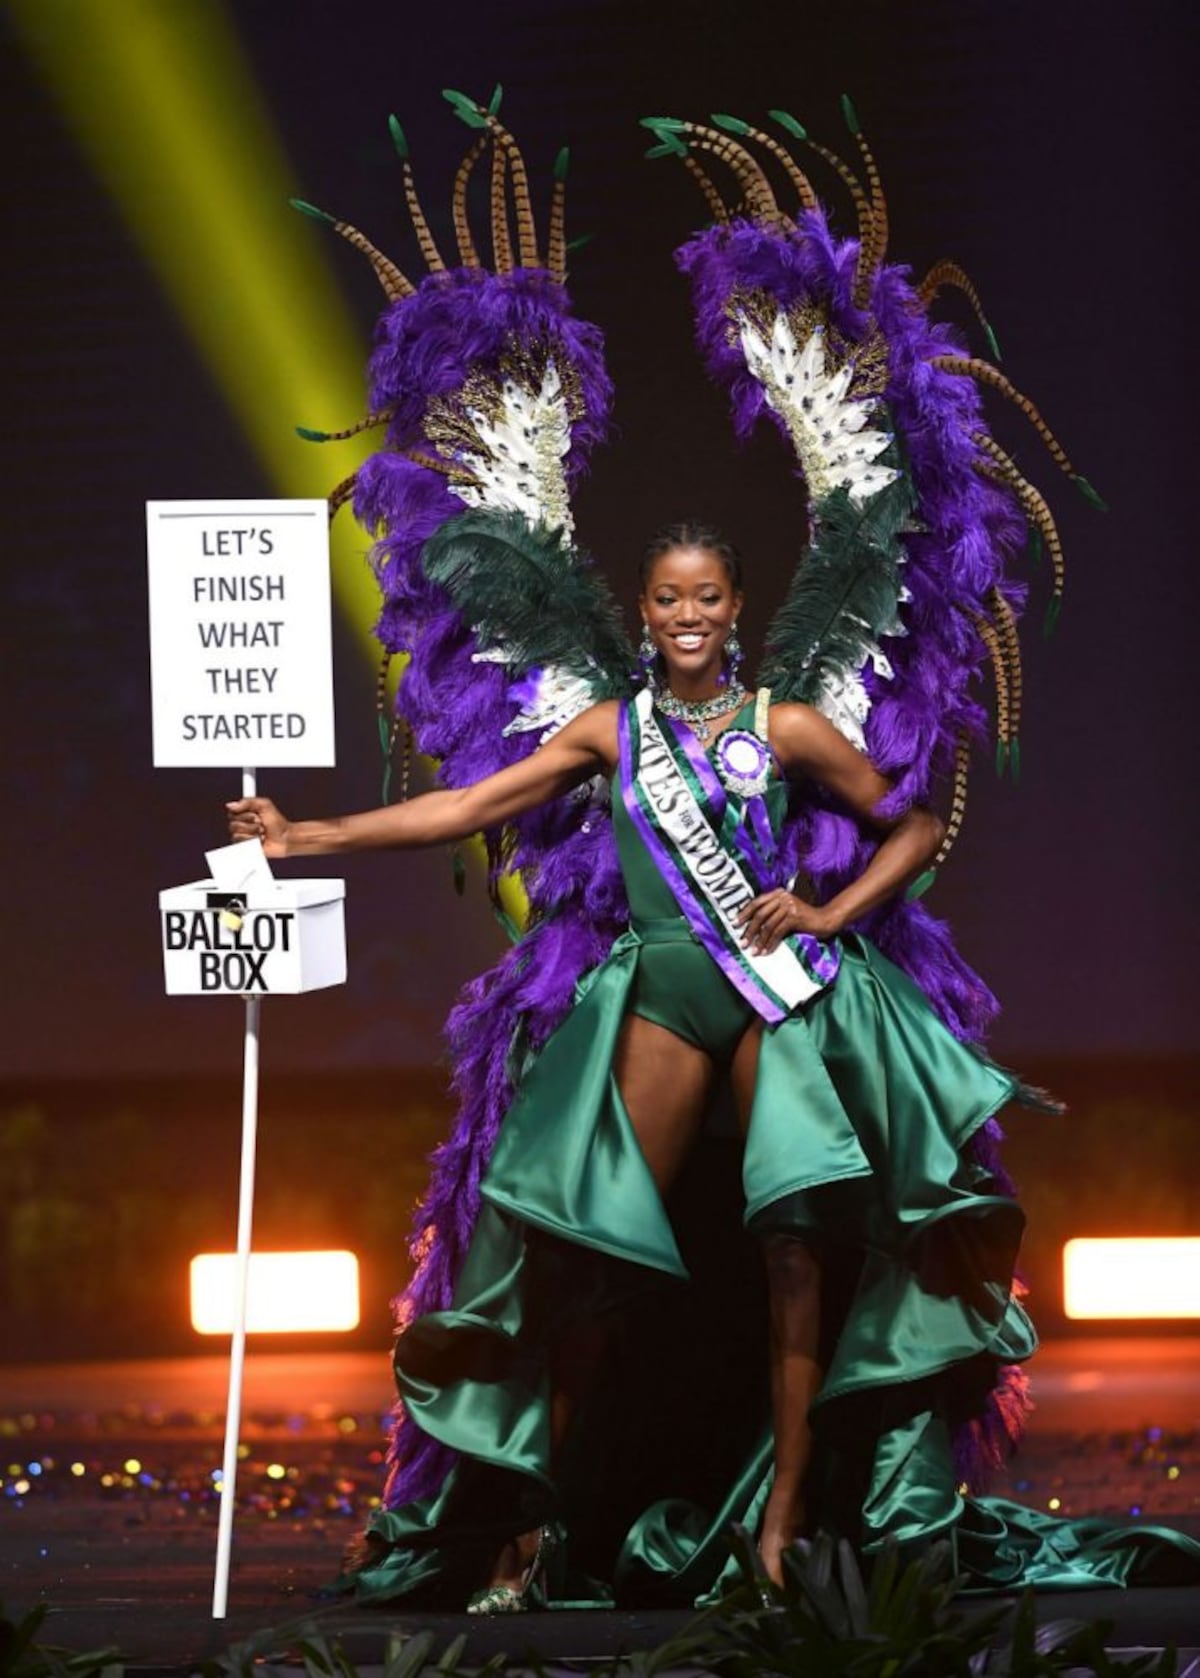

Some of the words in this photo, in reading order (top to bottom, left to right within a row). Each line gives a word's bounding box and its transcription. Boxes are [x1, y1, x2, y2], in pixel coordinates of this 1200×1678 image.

[194, 575, 285, 603] FINISH
[198, 621, 284, 648] WHAT
[206, 667, 278, 694] THEY
[182, 713, 306, 741] STARTED
[678, 809, 695, 829] FOR
[679, 821, 754, 940] WOME
[165, 911, 295, 951] BALLOT
[200, 952, 269, 991] BOX
